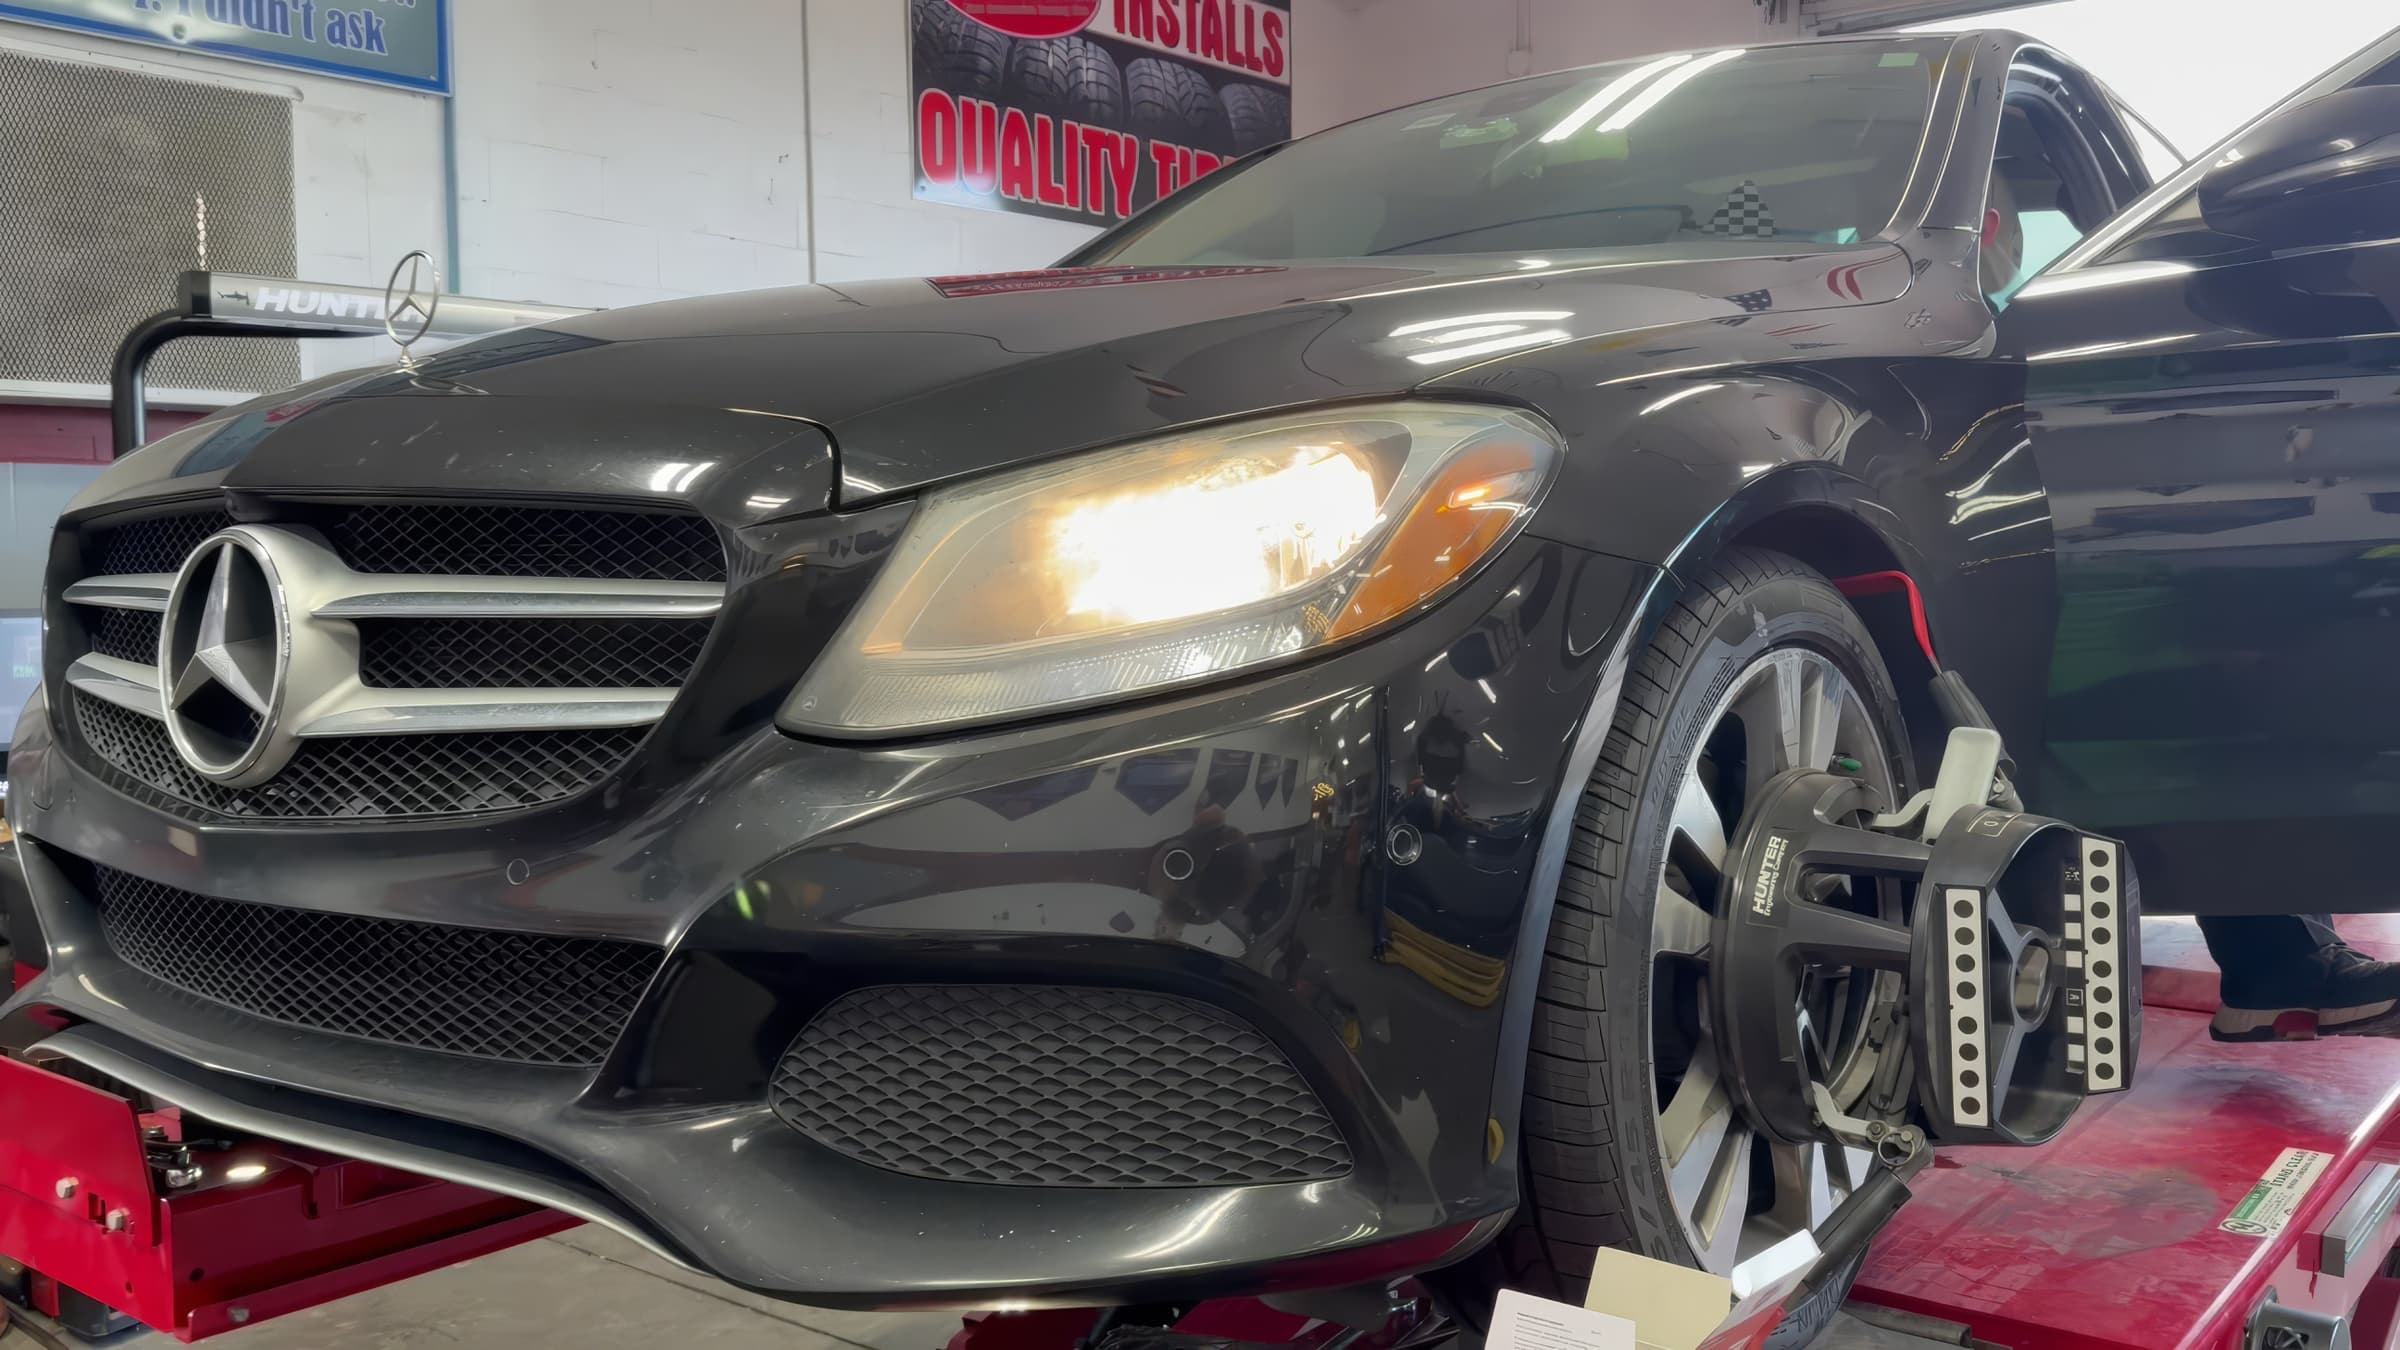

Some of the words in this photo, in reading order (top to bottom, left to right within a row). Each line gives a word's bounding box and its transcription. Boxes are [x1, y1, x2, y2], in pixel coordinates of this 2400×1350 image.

[325, 8, 388, 56] ask
[919, 87, 1139, 219] QUALITY
[1149, 139, 1239, 201] TI
[1752, 835, 1782, 915] HUNTER
